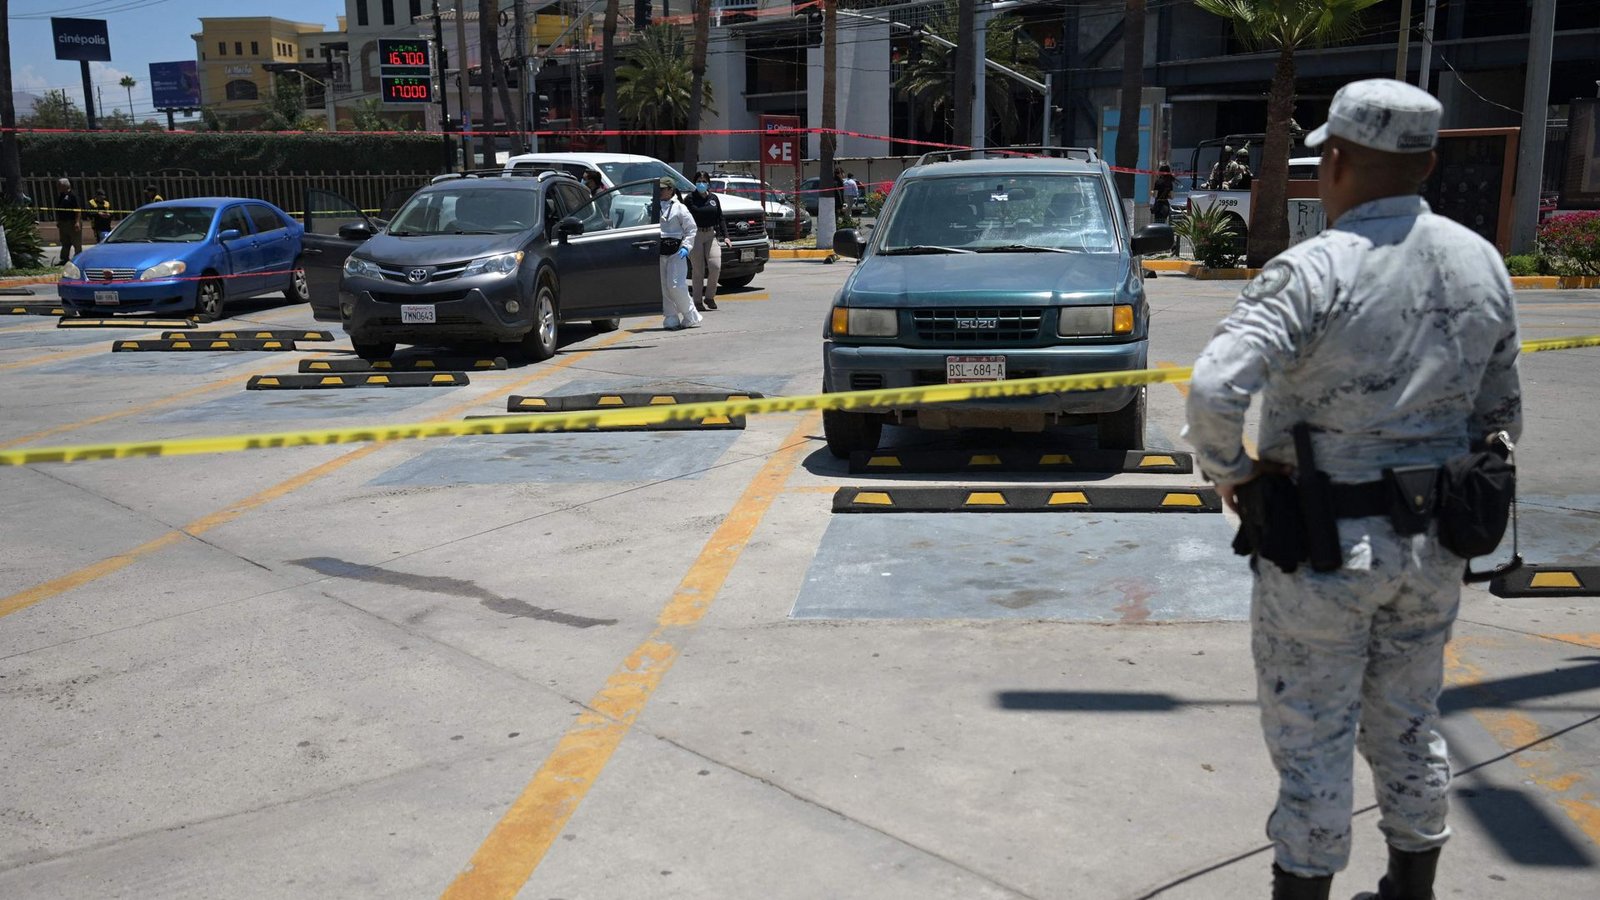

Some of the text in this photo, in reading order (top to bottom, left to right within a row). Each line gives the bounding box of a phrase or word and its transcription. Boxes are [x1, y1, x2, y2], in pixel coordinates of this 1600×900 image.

[58, 33, 106, 45] cinépolis
[389, 52, 424, 65] 16.700
[392, 85, 427, 98] 17.000
[782, 142, 792, 160] E
[957, 320, 997, 329] ISUZU
[949, 364, 1003, 376] BSL-684-A
